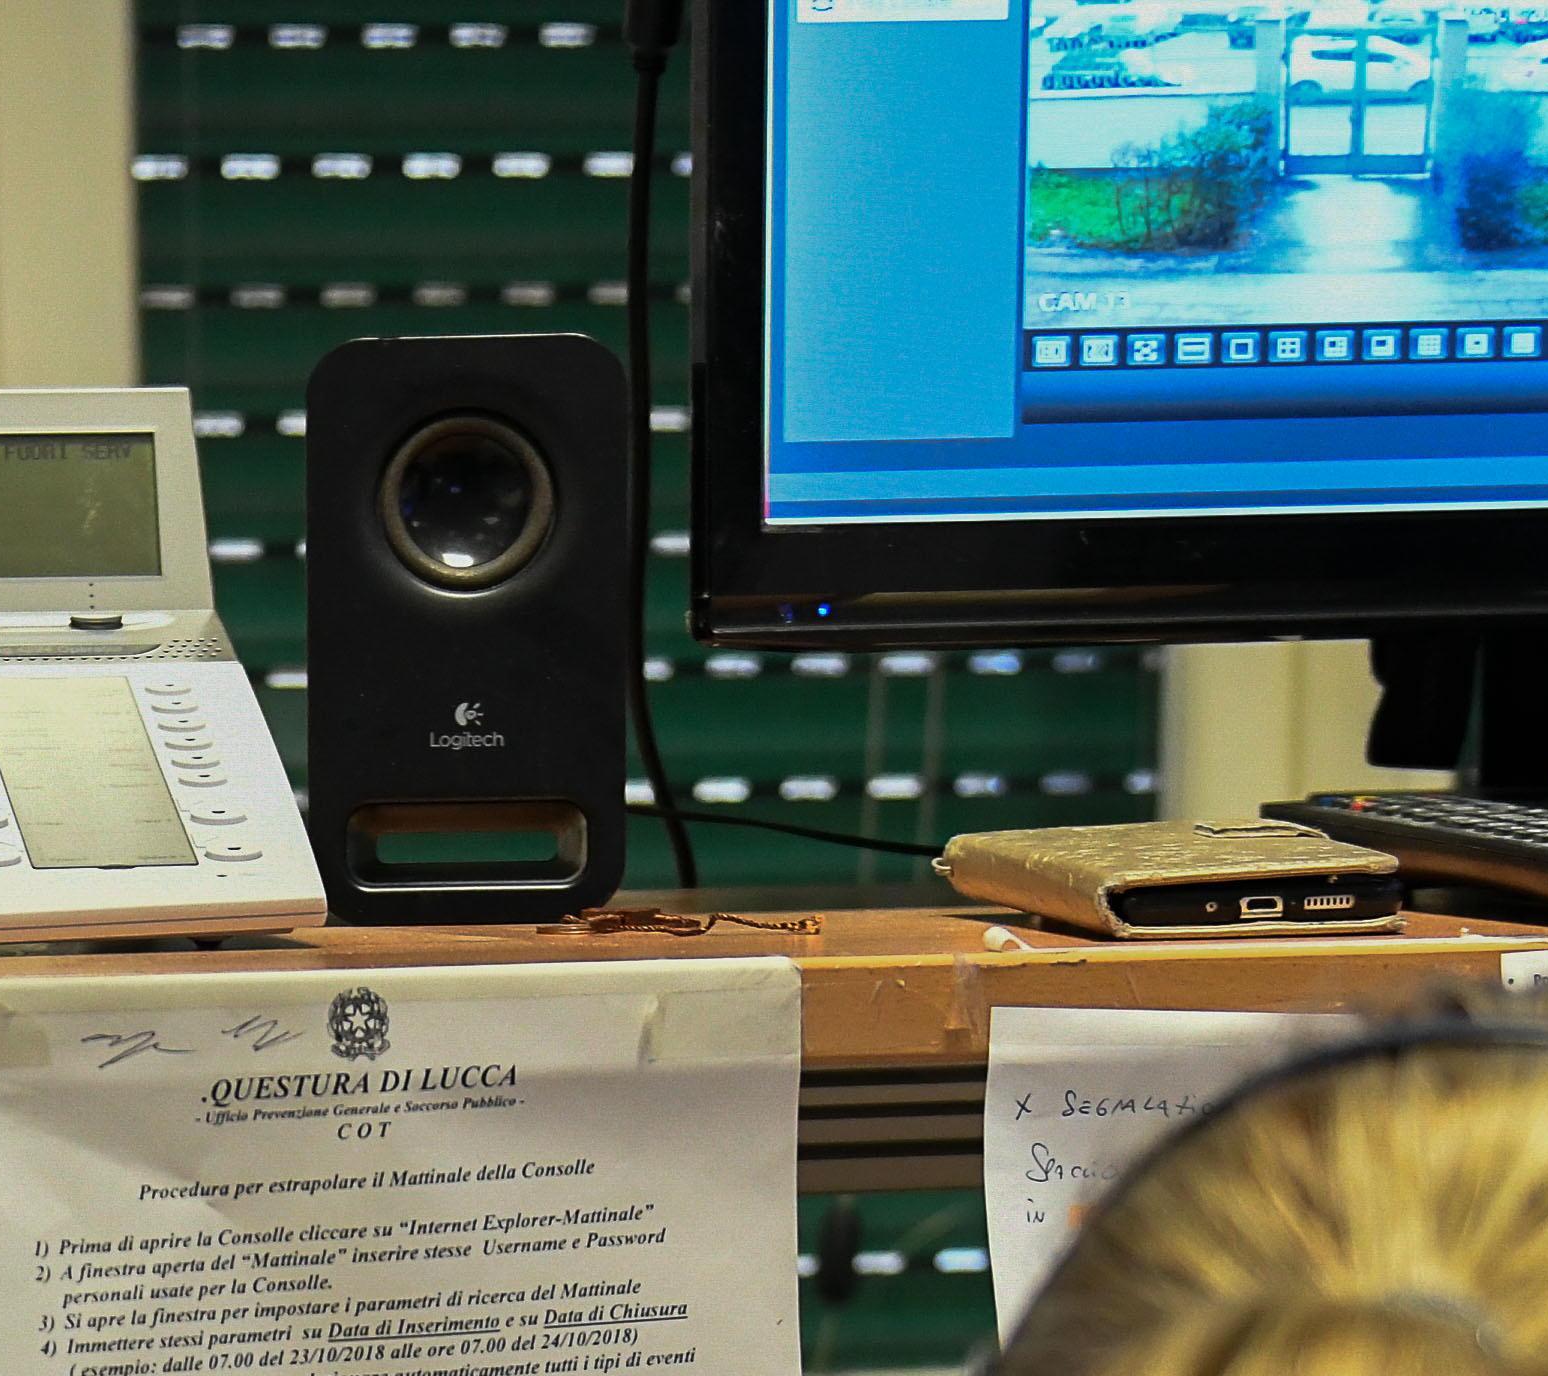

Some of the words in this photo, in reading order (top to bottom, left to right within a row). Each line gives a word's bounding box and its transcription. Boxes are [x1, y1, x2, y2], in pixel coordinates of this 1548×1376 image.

[1039, 292, 1097, 312] CAM
[430, 731, 504, 750] Logitech
[201, 1072, 369, 1105] .QUESTURA
[418, 1064, 516, 1092] LUCCA
[206, 1110, 248, 1126] Ufficio
[252, 1106, 329, 1121] Prevenzione
[333, 1102, 391, 1116] Generale
[404, 1101, 458, 1113] Soccorso
[462, 1095, 516, 1110] Pubblico
[138, 1181, 230, 1201] Procedura
[233, 1182, 264, 1201] per
[269, 1173, 367, 1196] estrapolare
[372, 1171, 385, 1188] il
[389, 1166, 471, 1188] Mattinale
[476, 1164, 516, 1181] della
[522, 1158, 595, 1179] Consolle
[34, 1240, 49, 1259] 1)
[59, 1238, 112, 1256] Prima
[117, 1235, 134, 1252] di
[139, 1232, 192, 1255] aprire
[197, 1230, 212, 1247] la
[218, 1226, 294, 1246] Consolle
[299, 1224, 368, 1242] cliccare
[373, 1226, 393, 1238] su
[35, 1265, 51, 1284] 2)
[60, 1264, 72, 1281] A
[76, 1262, 146, 1285] finestra
[152, 1259, 205, 1279] aperta
[211, 1254, 236, 1271] del
[352, 1245, 419, 1263] inserire
[423, 1245, 472, 1260] stesse
[483, 1239, 567, 1256] Username
[572, 1238, 581, 1250] e
[585, 1227, 666, 1248] Password
